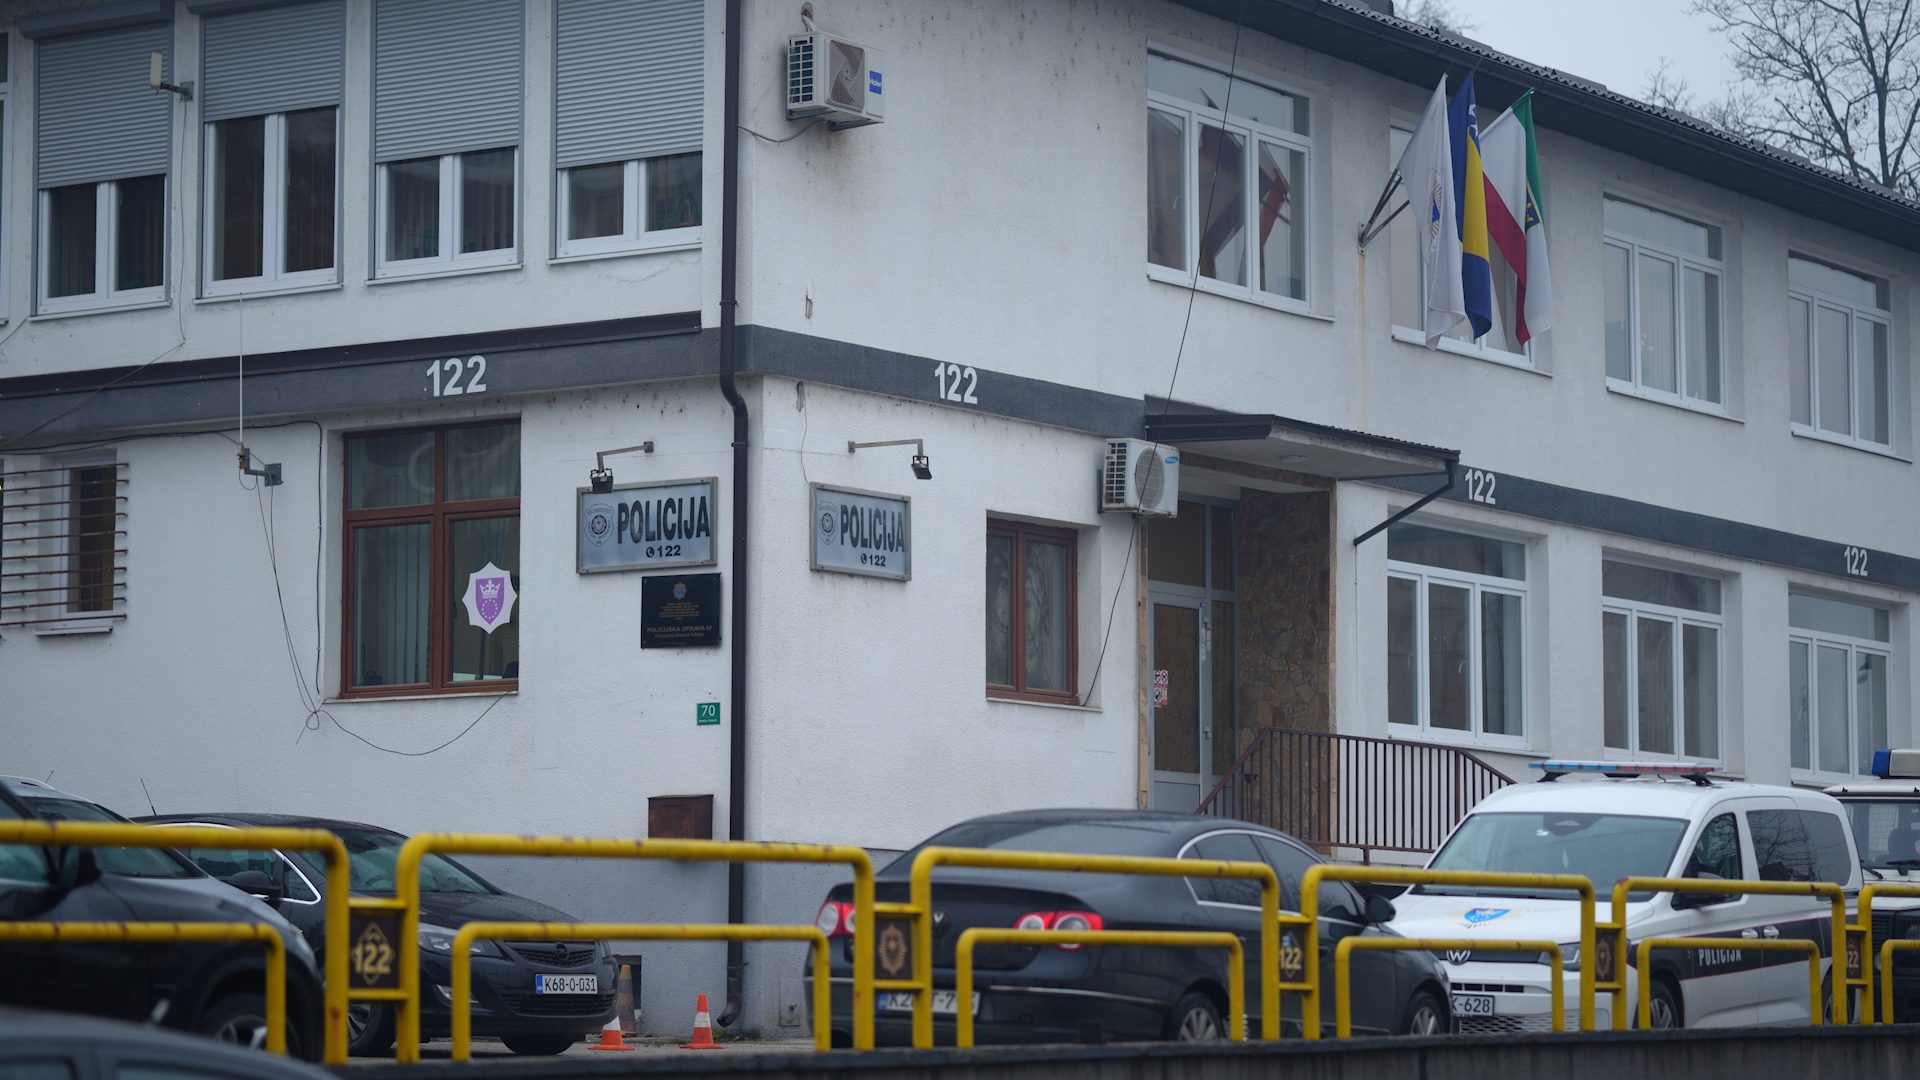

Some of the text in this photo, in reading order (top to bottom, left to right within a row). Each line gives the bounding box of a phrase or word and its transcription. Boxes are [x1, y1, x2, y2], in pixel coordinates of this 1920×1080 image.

[427, 355, 487, 397] 122
[935, 362, 977, 405] 122
[1465, 468, 1496, 505] 122
[618, 496, 710, 544] POLICIJA
[841, 504, 905, 553] POLICIJA
[657, 545, 681, 558] 122
[869, 554, 886, 567] 122
[1844, 546, 1868, 577] 122
[701, 705, 715, 716] 70
[354, 943, 391, 974] 122
[1280, 947, 1302, 969] 122
